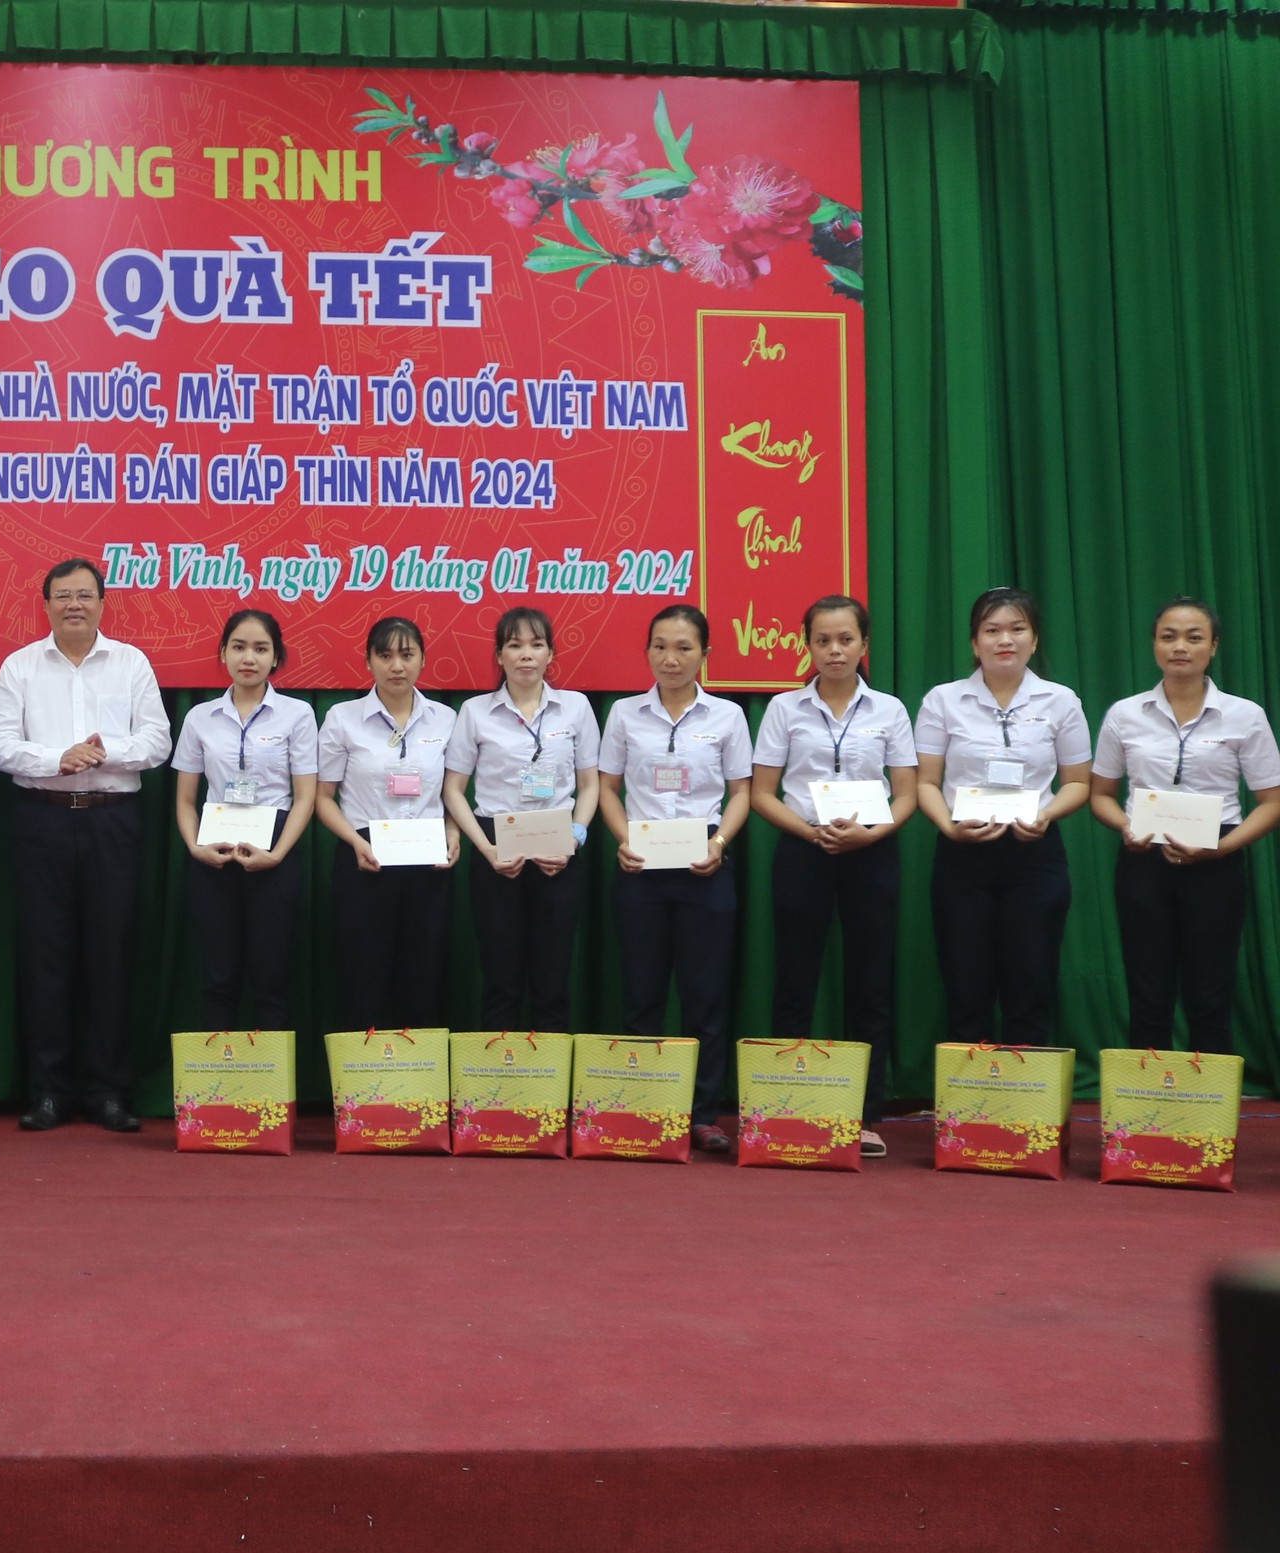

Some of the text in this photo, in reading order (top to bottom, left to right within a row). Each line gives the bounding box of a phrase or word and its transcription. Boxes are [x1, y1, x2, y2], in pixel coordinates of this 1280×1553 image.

[204, 136, 381, 202] TRÌNH
[96, 236, 293, 340] QUÀ
[308, 232, 492, 328] TẾT
[743, 322, 785, 366] An
[67, 361, 167, 427] NƯỚC,
[176, 364, 259, 433] MẶT
[267, 365, 360, 435] TRẬN
[368, 360, 419, 426] TỔ
[423, 363, 519, 427] QUỐC
[523, 369, 596, 437] VIỆT
[603, 380, 688, 432] NAM
[123, 442, 202, 503] ĐÁN
[207, 443, 286, 504] GIÁP
[295, 444, 373, 507] THÌN
[378, 449, 461, 507] NĂM
[470, 458, 556, 509] 2024
[721, 419, 824, 484] Khang
[737, 506, 802, 569] Thịnh
[102, 542, 694, 604] Trà Vinh, ngày 19 tháng 01 năm 2024
[733, 600, 812, 676] Vượng
